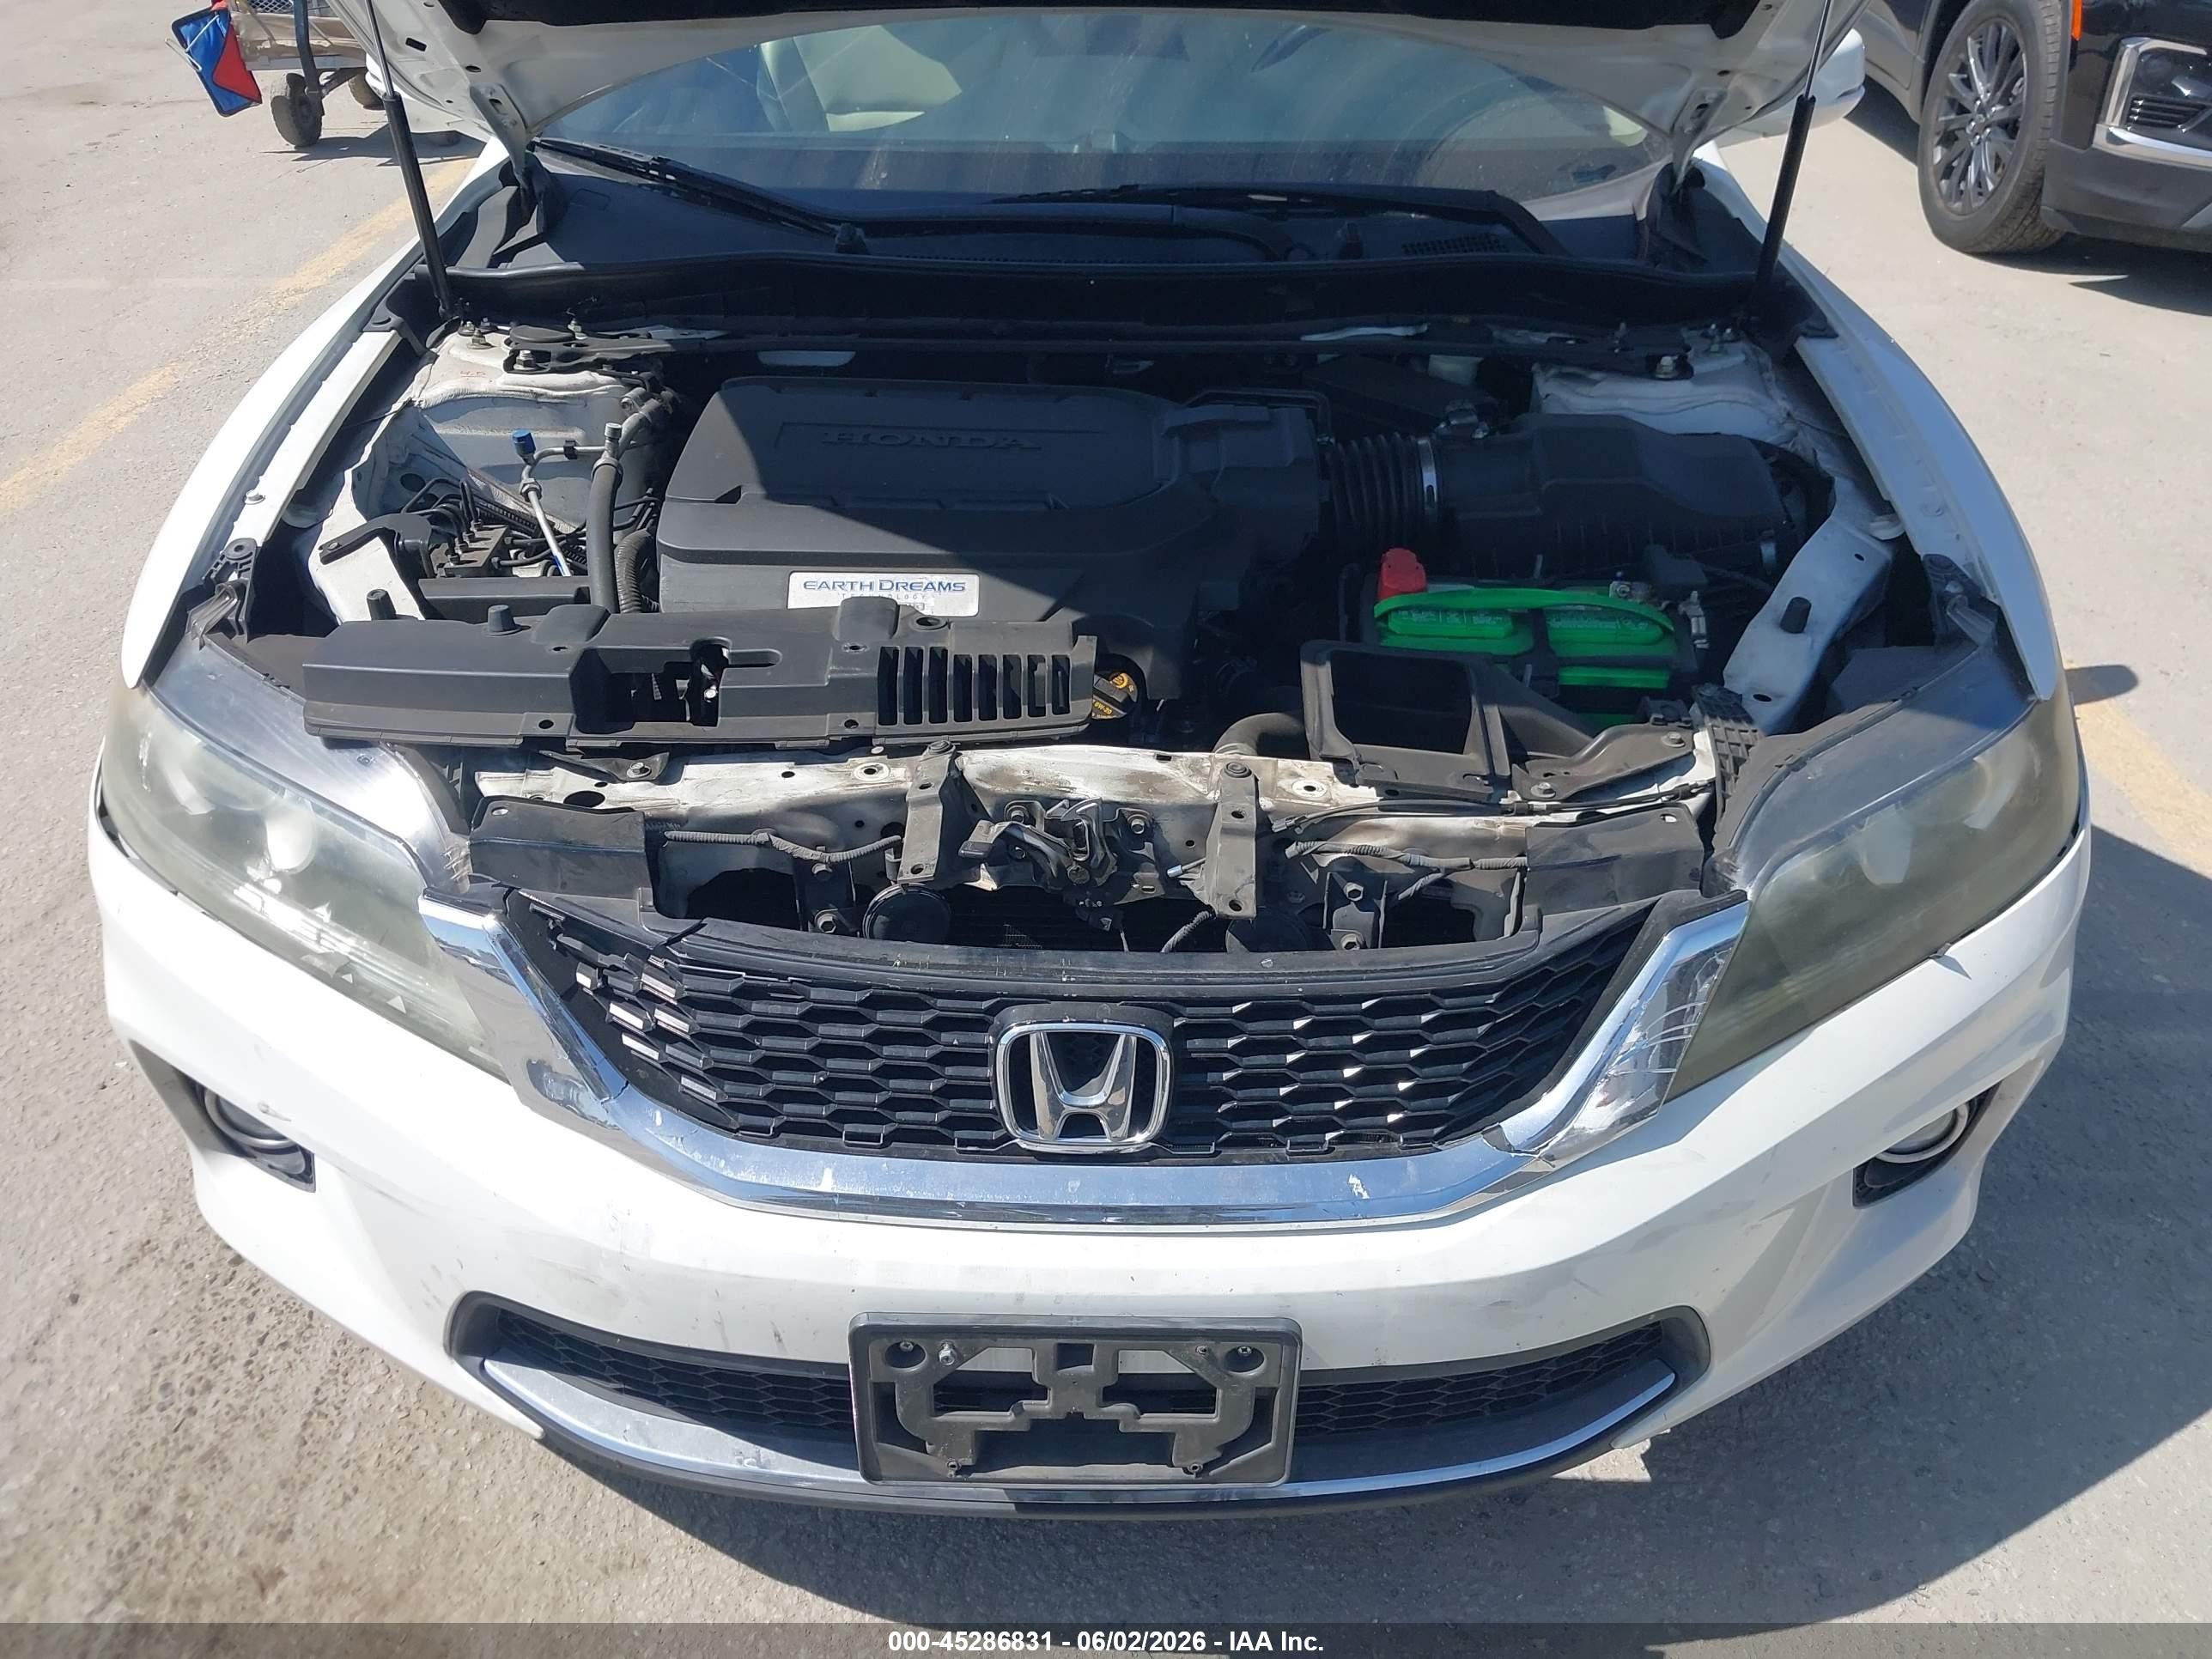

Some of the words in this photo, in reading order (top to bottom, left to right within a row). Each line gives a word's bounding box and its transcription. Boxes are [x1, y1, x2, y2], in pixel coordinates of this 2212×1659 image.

[821, 431, 1042, 450] HONDA
[802, 580, 874, 592] EARTH
[878, 579, 966, 592] DREAMS
